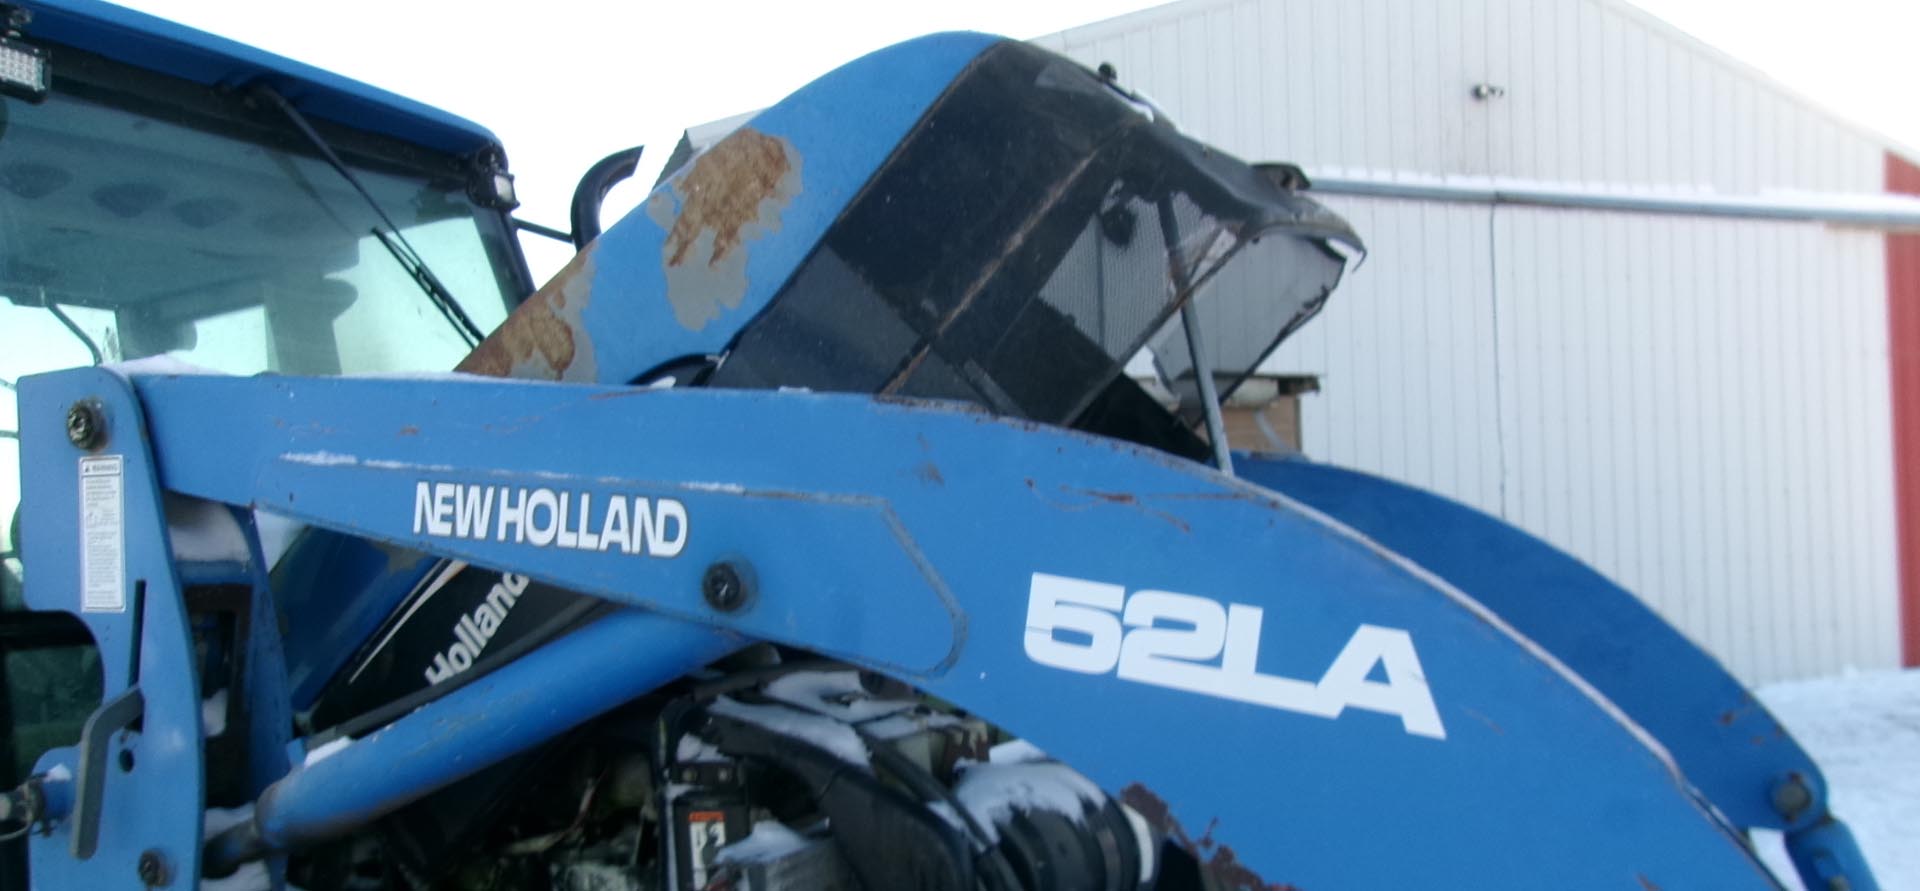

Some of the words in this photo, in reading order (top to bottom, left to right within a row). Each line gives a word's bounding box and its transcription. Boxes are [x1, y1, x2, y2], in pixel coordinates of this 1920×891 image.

[413, 481, 494, 539] NEW
[497, 487, 688, 557] HOLLAND
[1023, 572, 1447, 740] 52LA
